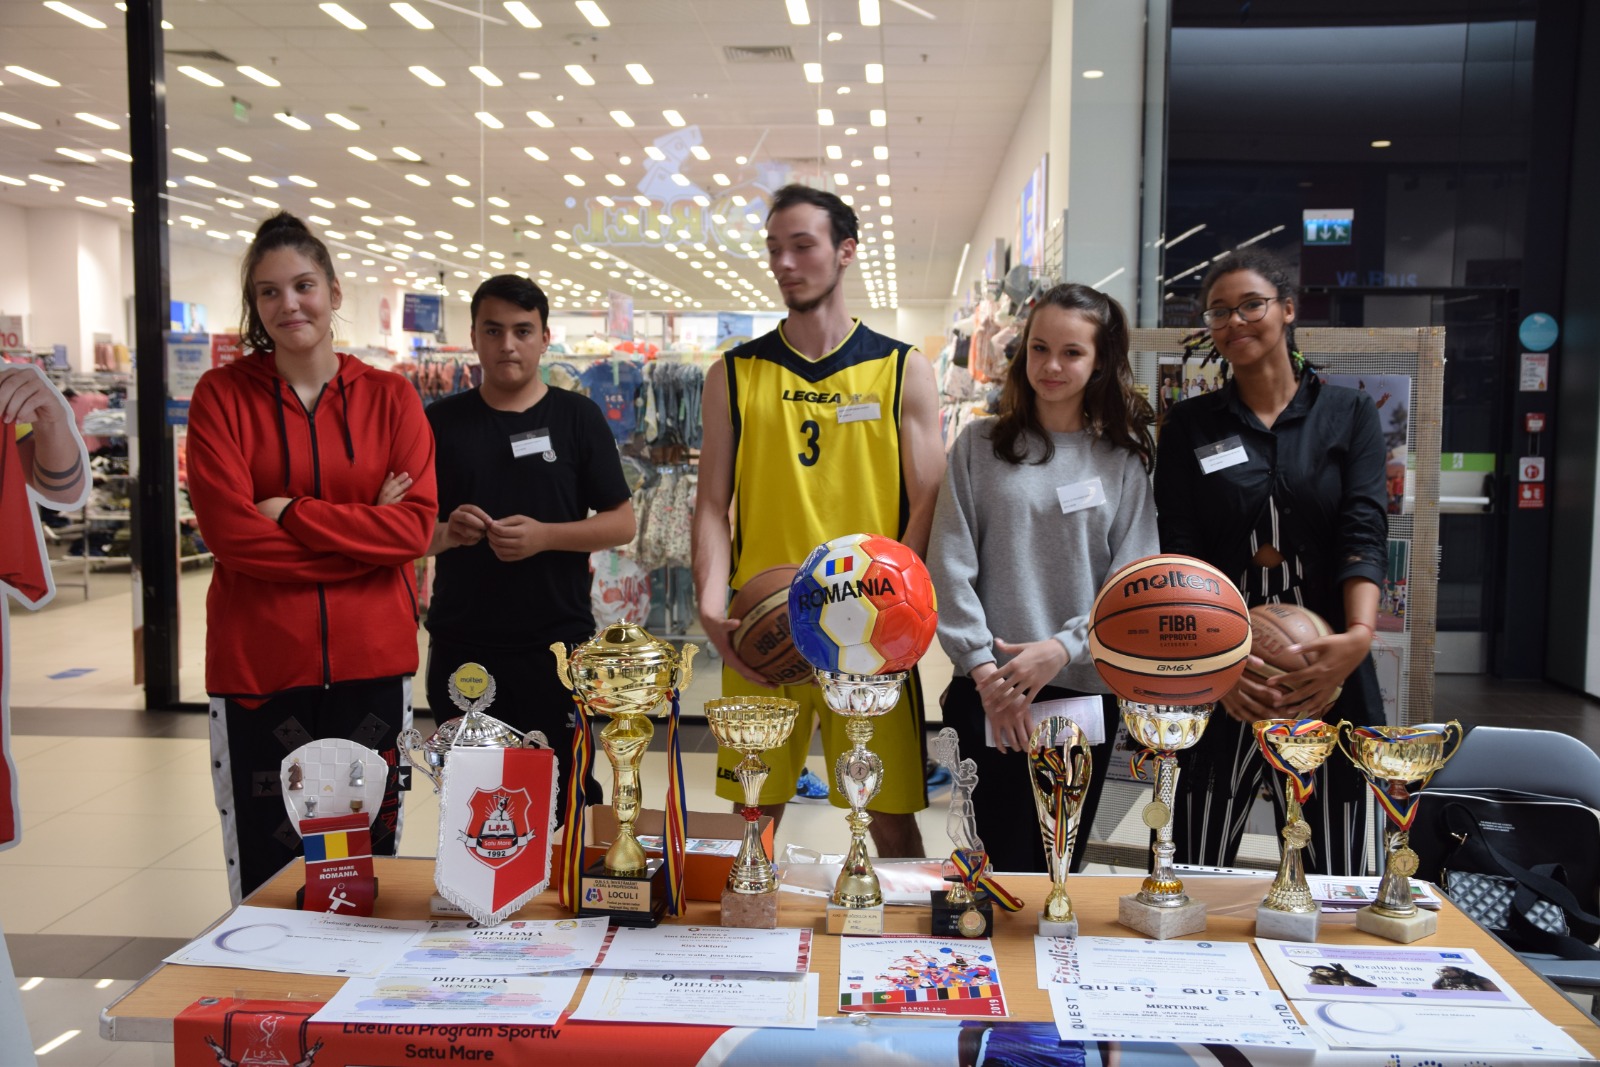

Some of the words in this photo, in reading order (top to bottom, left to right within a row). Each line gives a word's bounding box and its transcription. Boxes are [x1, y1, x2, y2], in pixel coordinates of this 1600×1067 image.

[782, 390, 841, 403] LEGEA
[798, 420, 820, 467] 3
[1124, 571, 1220, 598] molten
[798, 577, 896, 613] ROMANIA
[1159, 615, 1196, 631] FIBA
[1159, 633, 1197, 641] APPROVED
[460, 676, 483, 684] molten
[319, 870, 359, 880] ROMANIA
[608, 891, 633, 900] LOCUL
[635, 892, 638, 900] I
[432, 976, 509, 984] DIPLOMĂ
[1079, 984, 1157, 993] QUEST
[1183, 987, 1262, 996] QUEST
[990, 999, 1002, 1015] 2019
[1066, 996, 1085, 1030] QUEST
[1274, 1004, 1305, 1037] QUEST
[418, 1023, 493, 1042] Program
[497, 1024, 561, 1041] Sportiv
[405, 1044, 446, 1060] Satu
[449, 1045, 495, 1061] Mare
